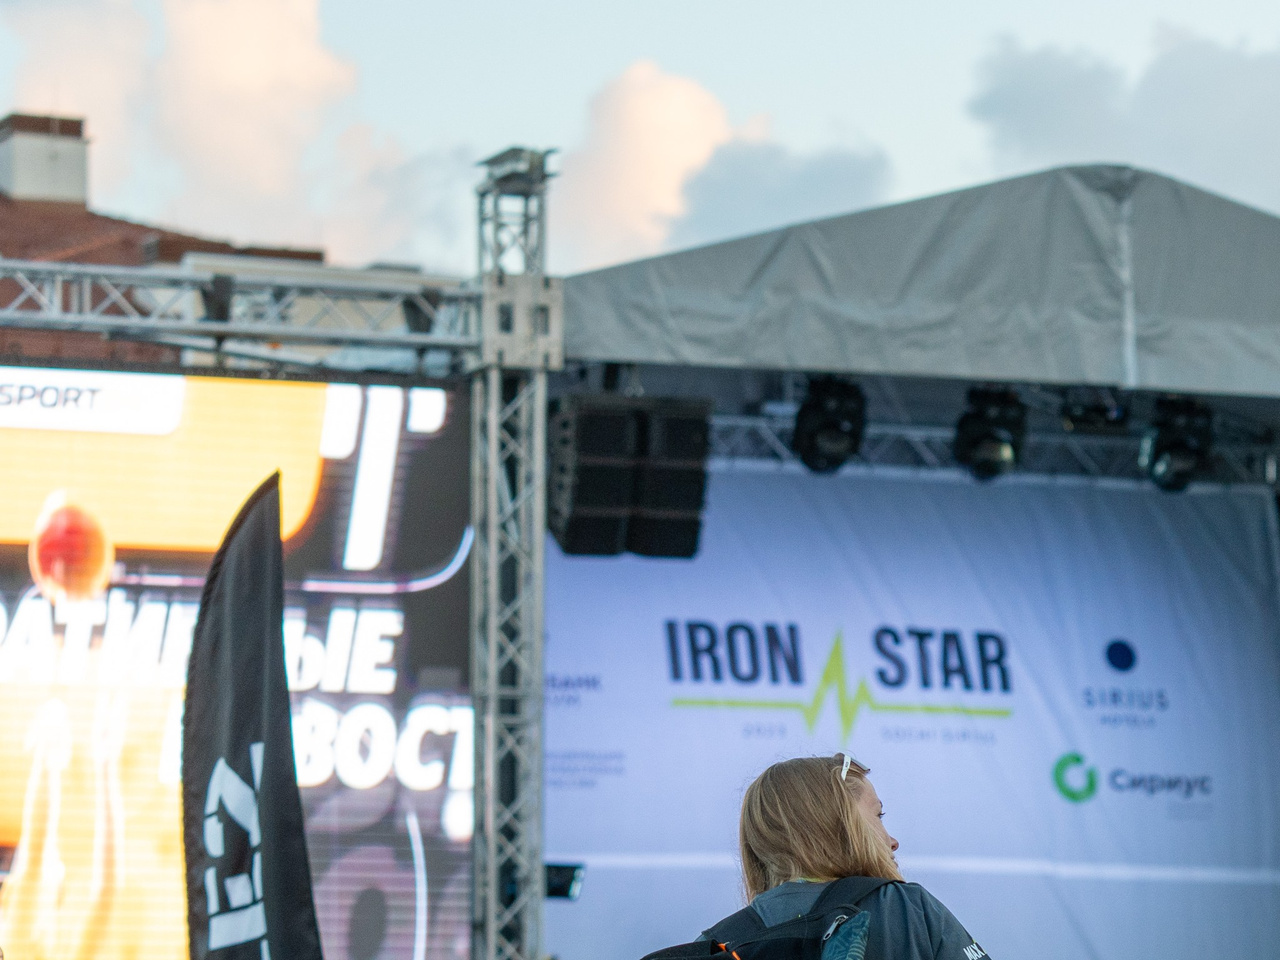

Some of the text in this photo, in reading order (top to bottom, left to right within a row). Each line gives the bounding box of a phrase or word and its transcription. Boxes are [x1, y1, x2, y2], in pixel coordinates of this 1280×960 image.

[665, 619, 1013, 693] IRON STAR
[1108, 767, 1212, 798] Сириус
